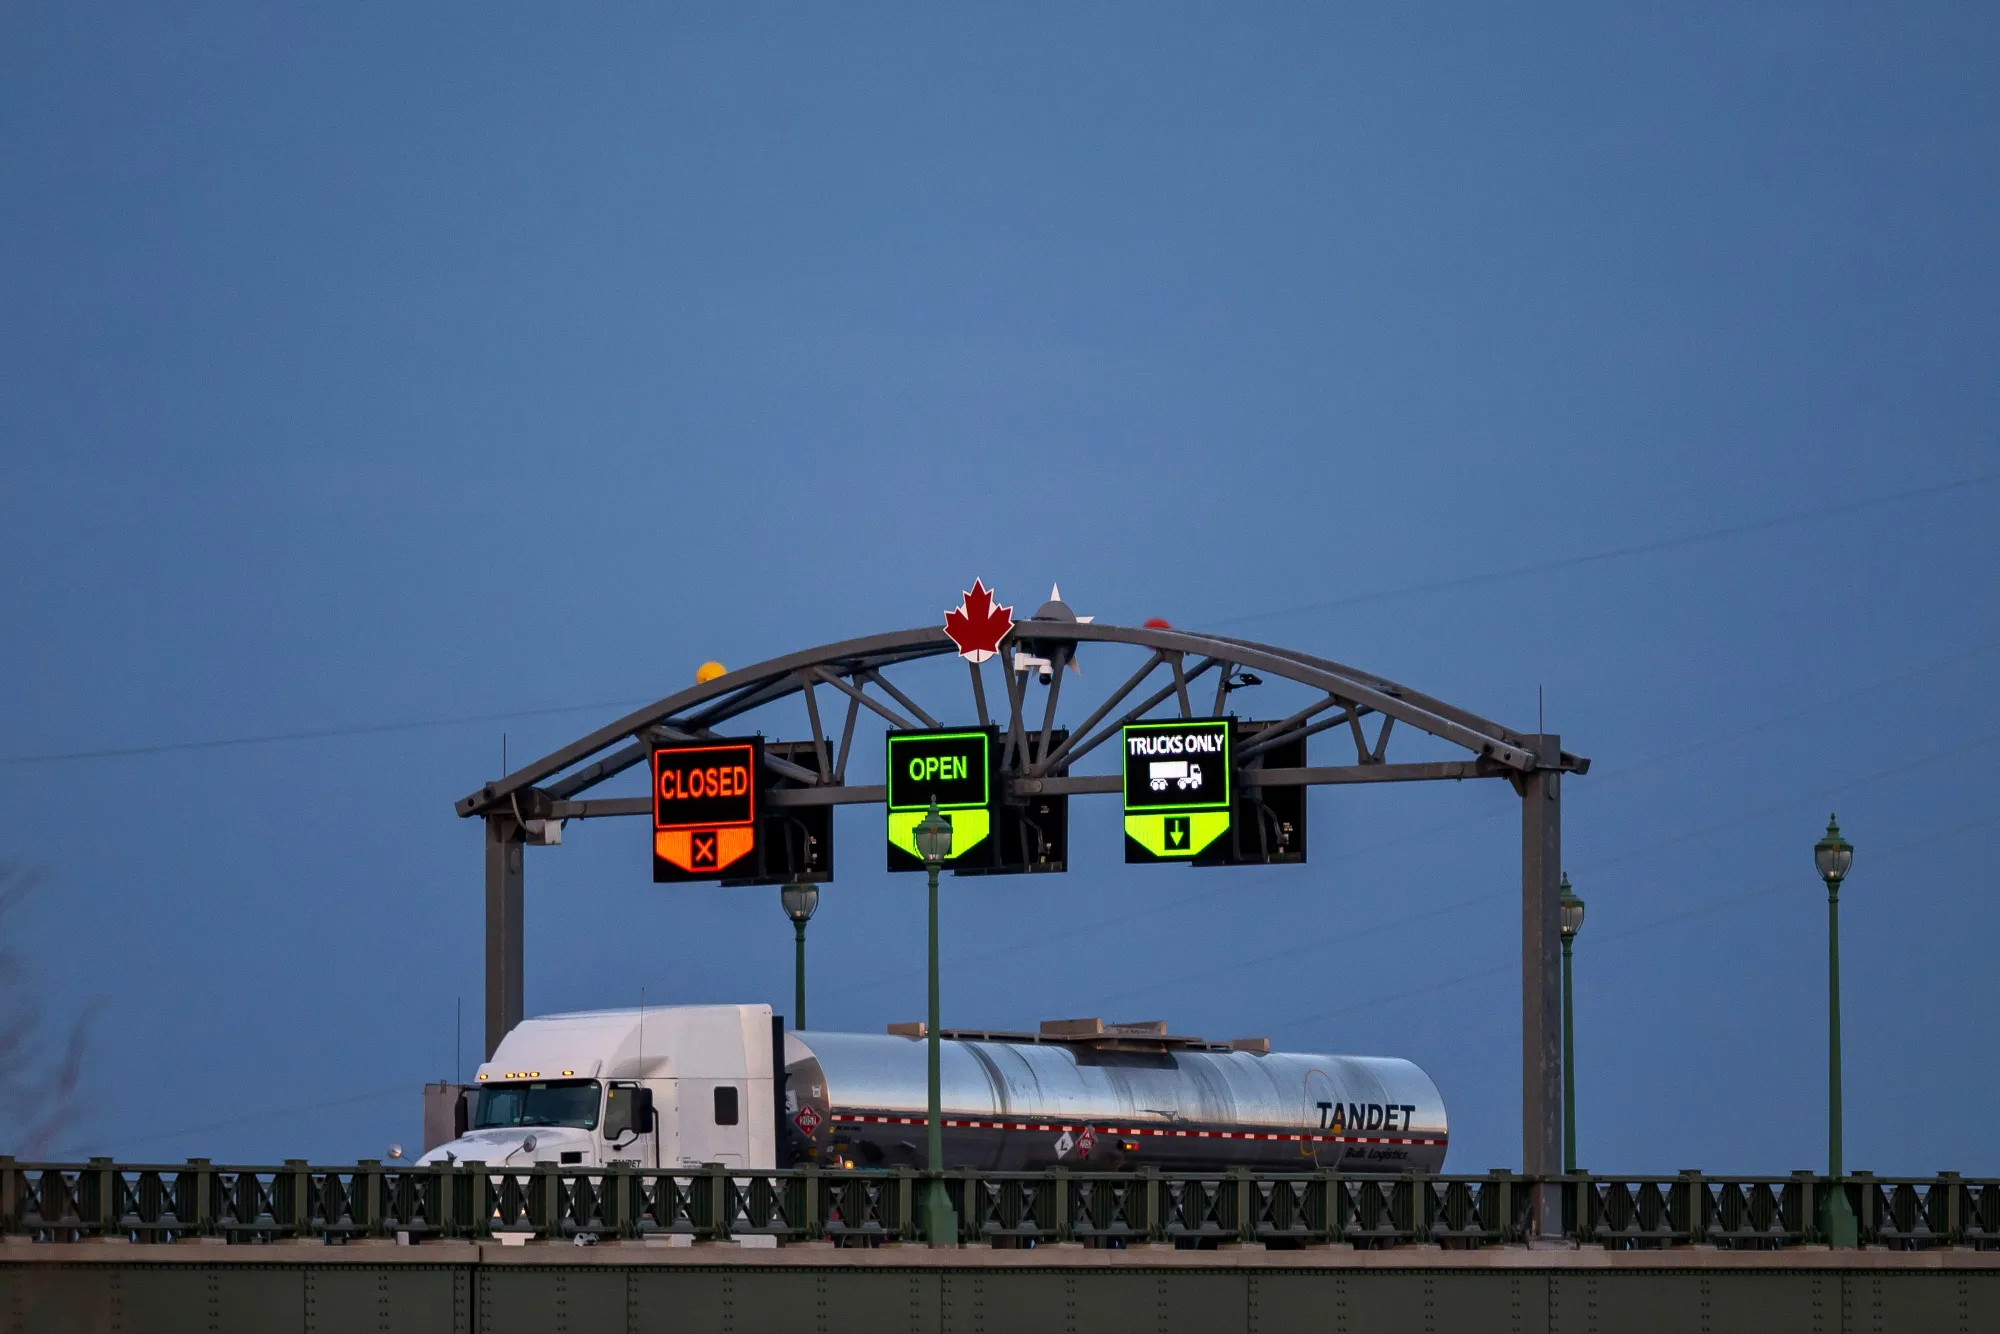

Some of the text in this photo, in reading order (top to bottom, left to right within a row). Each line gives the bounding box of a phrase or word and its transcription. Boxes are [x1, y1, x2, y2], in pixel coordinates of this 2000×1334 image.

[1127, 734, 1224, 755] TRUCKS ONLY
[909, 756, 967, 781] OPEN
[660, 766, 748, 799] CLOSED
[1316, 1102, 1415, 1132] TANDET
[1345, 1147, 1408, 1162] Bulk Logistics
